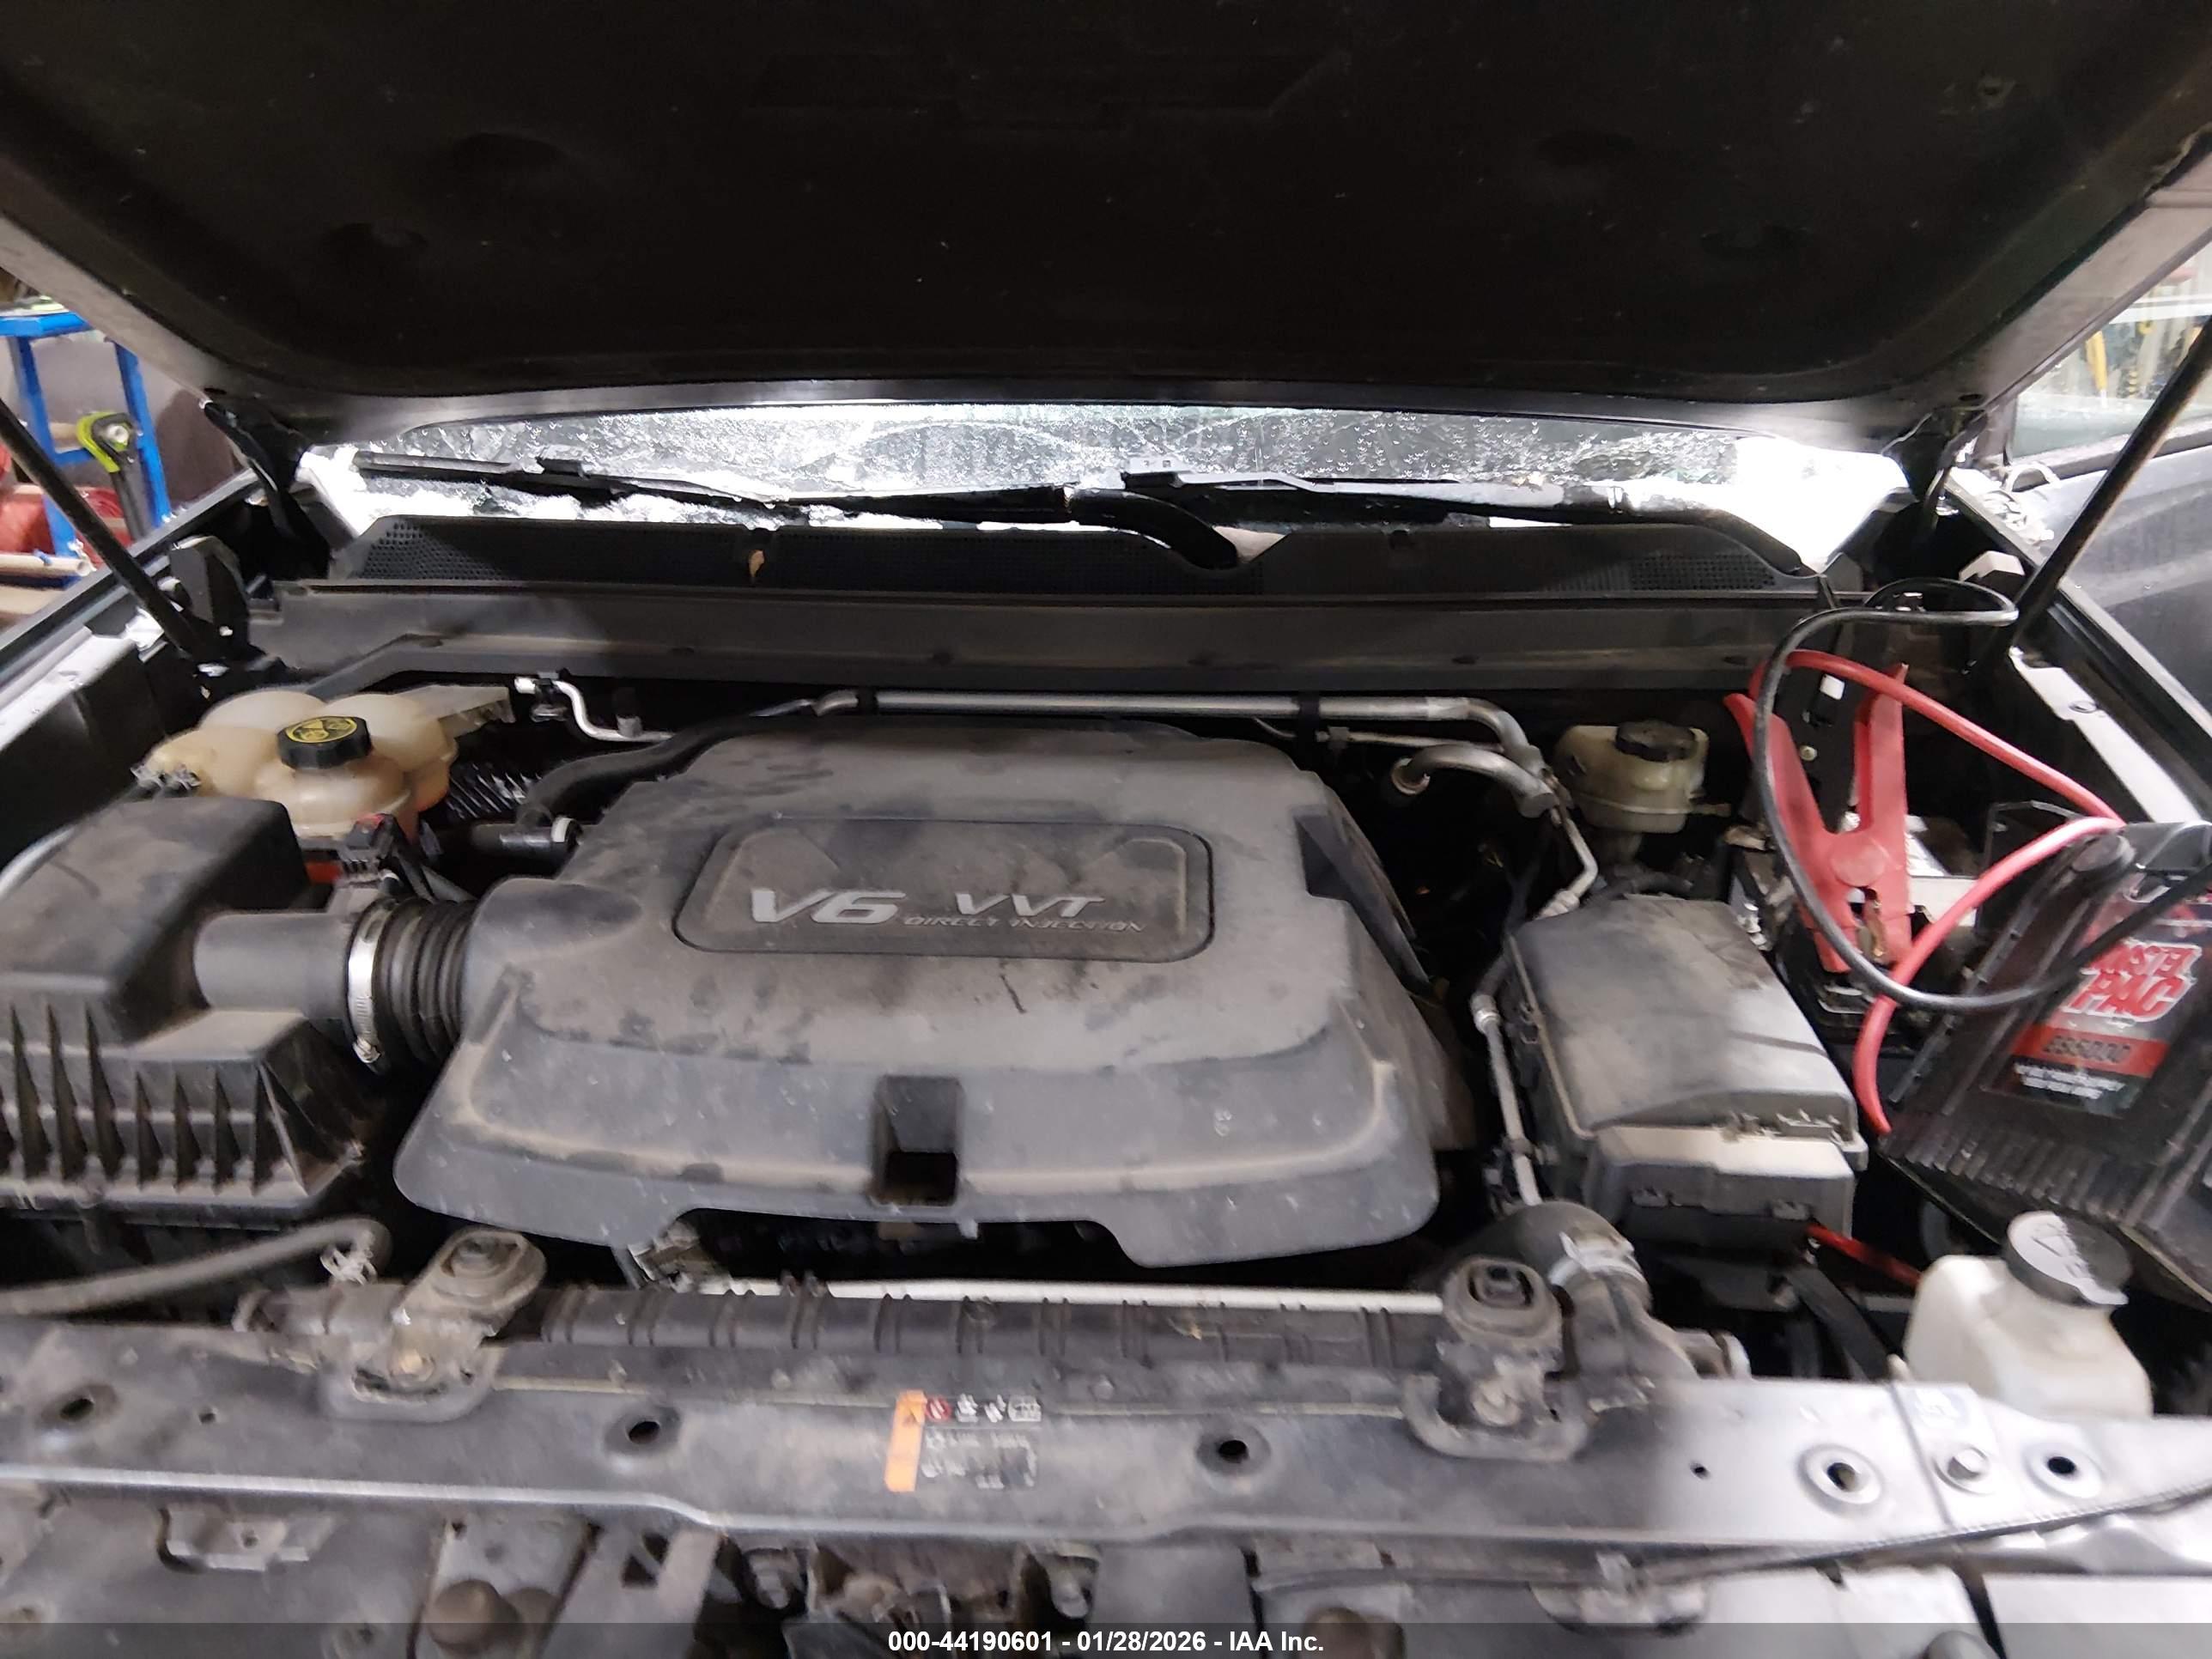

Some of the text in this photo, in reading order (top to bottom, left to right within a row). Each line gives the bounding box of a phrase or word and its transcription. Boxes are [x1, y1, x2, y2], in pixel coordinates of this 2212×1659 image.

[750, 888, 1105, 924] V6 VVT
[904, 916, 1144, 933] DIRECT INJECTION
[2066, 972, 2191, 1018] PAC
